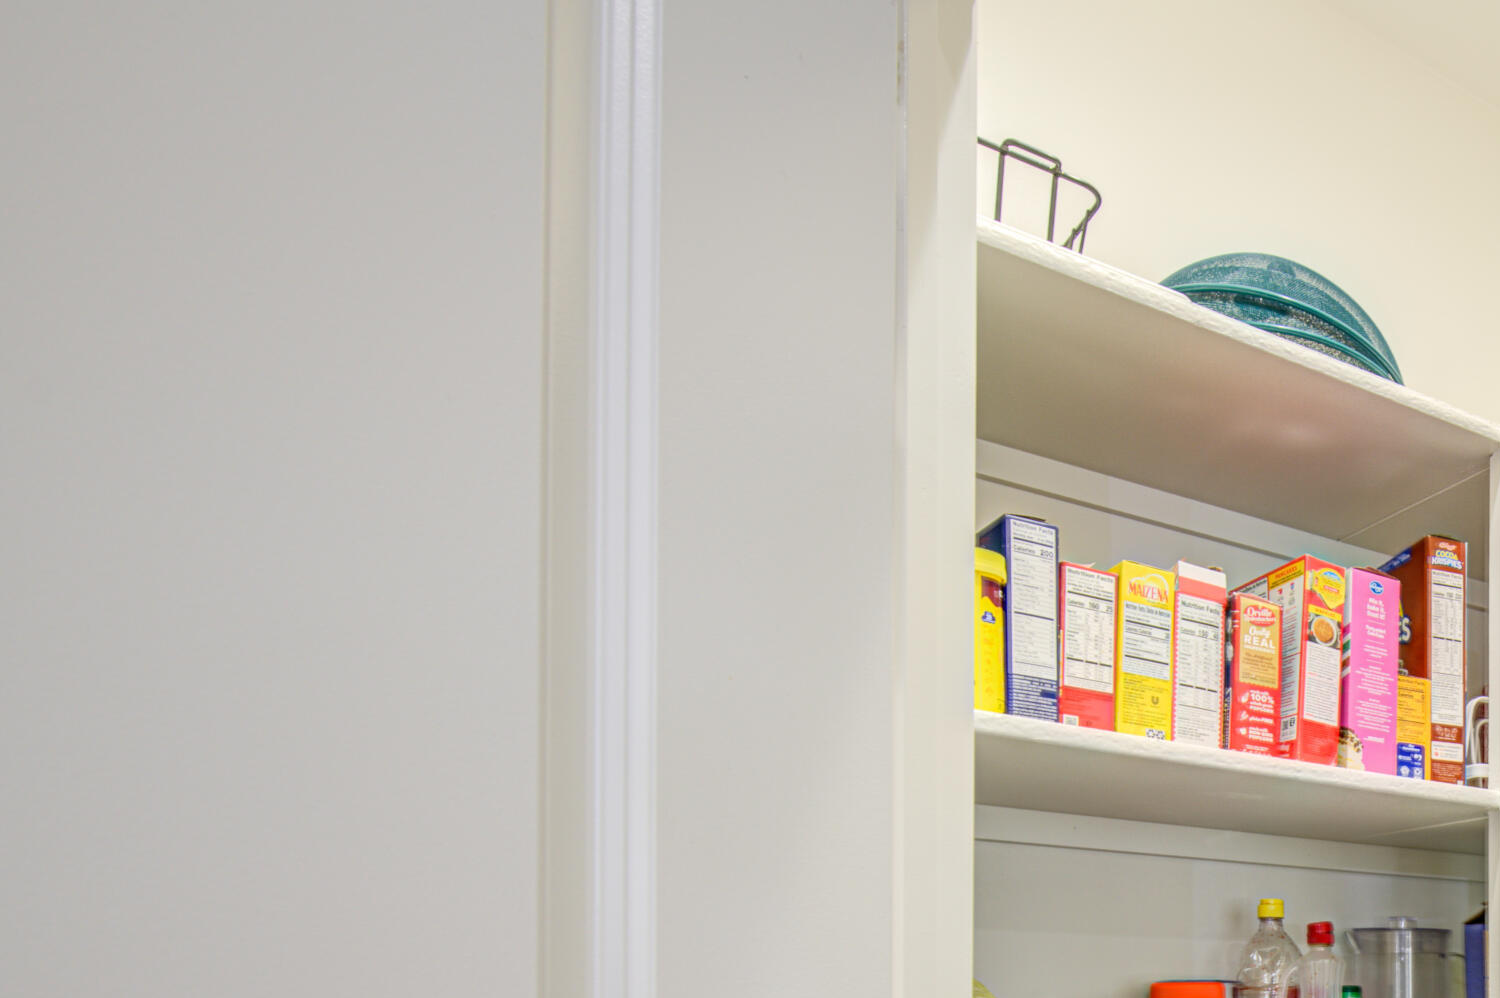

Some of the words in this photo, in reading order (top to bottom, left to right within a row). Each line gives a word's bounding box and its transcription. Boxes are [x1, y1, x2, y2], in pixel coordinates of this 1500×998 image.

[1040, 549, 1054, 559] 200
[1435, 549, 1458, 560] COCOA
[1431, 555, 1463, 570] KRISPIES
[1128, 580, 1169, 604] MAIZENA
[1244, 634, 1275, 649] REAL
[1250, 693, 1274, 704] 100%
